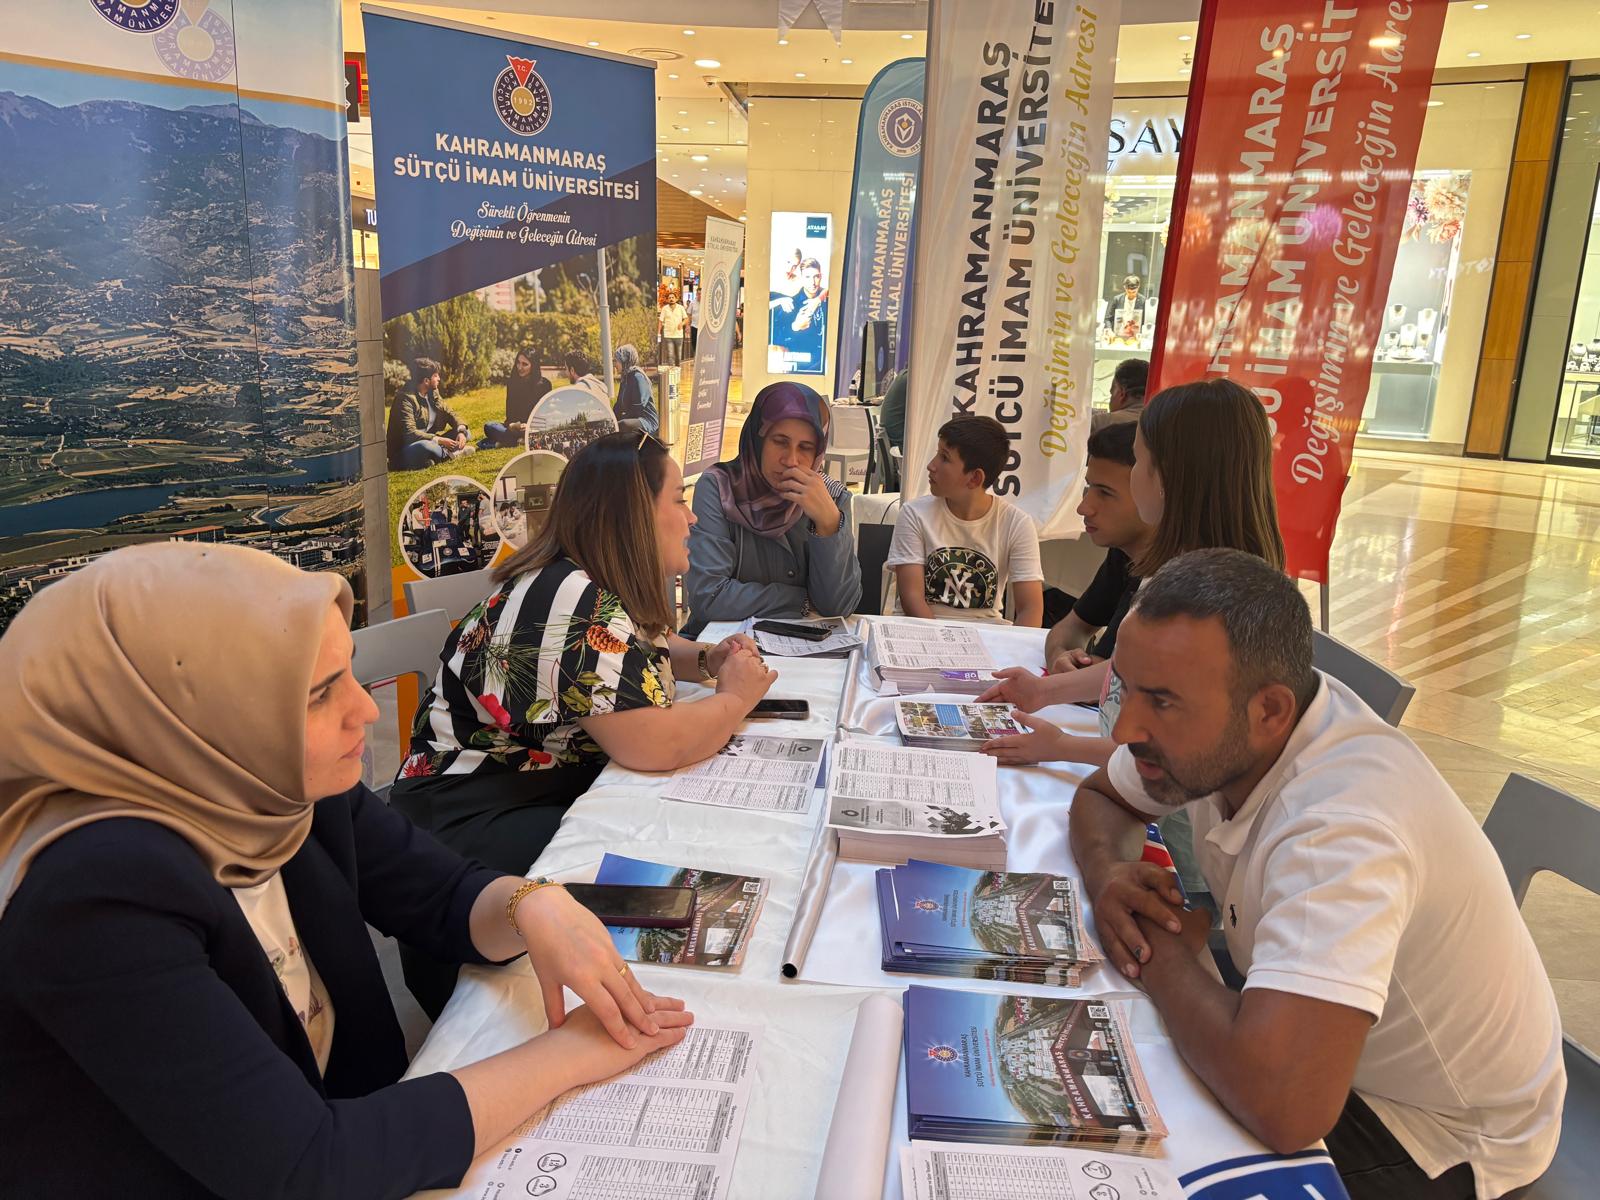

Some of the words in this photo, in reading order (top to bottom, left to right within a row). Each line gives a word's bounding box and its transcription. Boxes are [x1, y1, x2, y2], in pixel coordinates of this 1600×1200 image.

[1065, 5, 1097, 116] Adresi
[1366, 0, 1413, 93] Adre
[393, 153, 460, 184] SÜTÇÜ
[465, 163, 517, 188] İMAM
[522, 168, 640, 201] ÜNİVERSİTESİ
[435, 132, 606, 174] KAHRAMANMARAŞ
[1051, 121, 1090, 264] Geleceğin
[1332, 100, 1397, 266] Geleceğin
[450, 219, 504, 241] Değişimin
[505, 230, 517, 240] ve
[518, 226, 564, 246] Geleceğin
[565, 228, 597, 246] Adresi
[477, 200, 515, 221] Sürekli
[516, 202, 571, 225] Öğrenmenin
[888, 172, 915, 279] ÜNİVERSİTESİ
[952, 41, 1019, 420] KAHRAMANMARAŞ
[992, 258, 1032, 362] İMAM
[1056, 272, 1075, 302] ve
[1244, 260, 1306, 375] İMAM
[1333, 275, 1360, 318] ve
[1039, 310, 1076, 458] Değişimin
[1292, 319, 1350, 484] Değişimin
